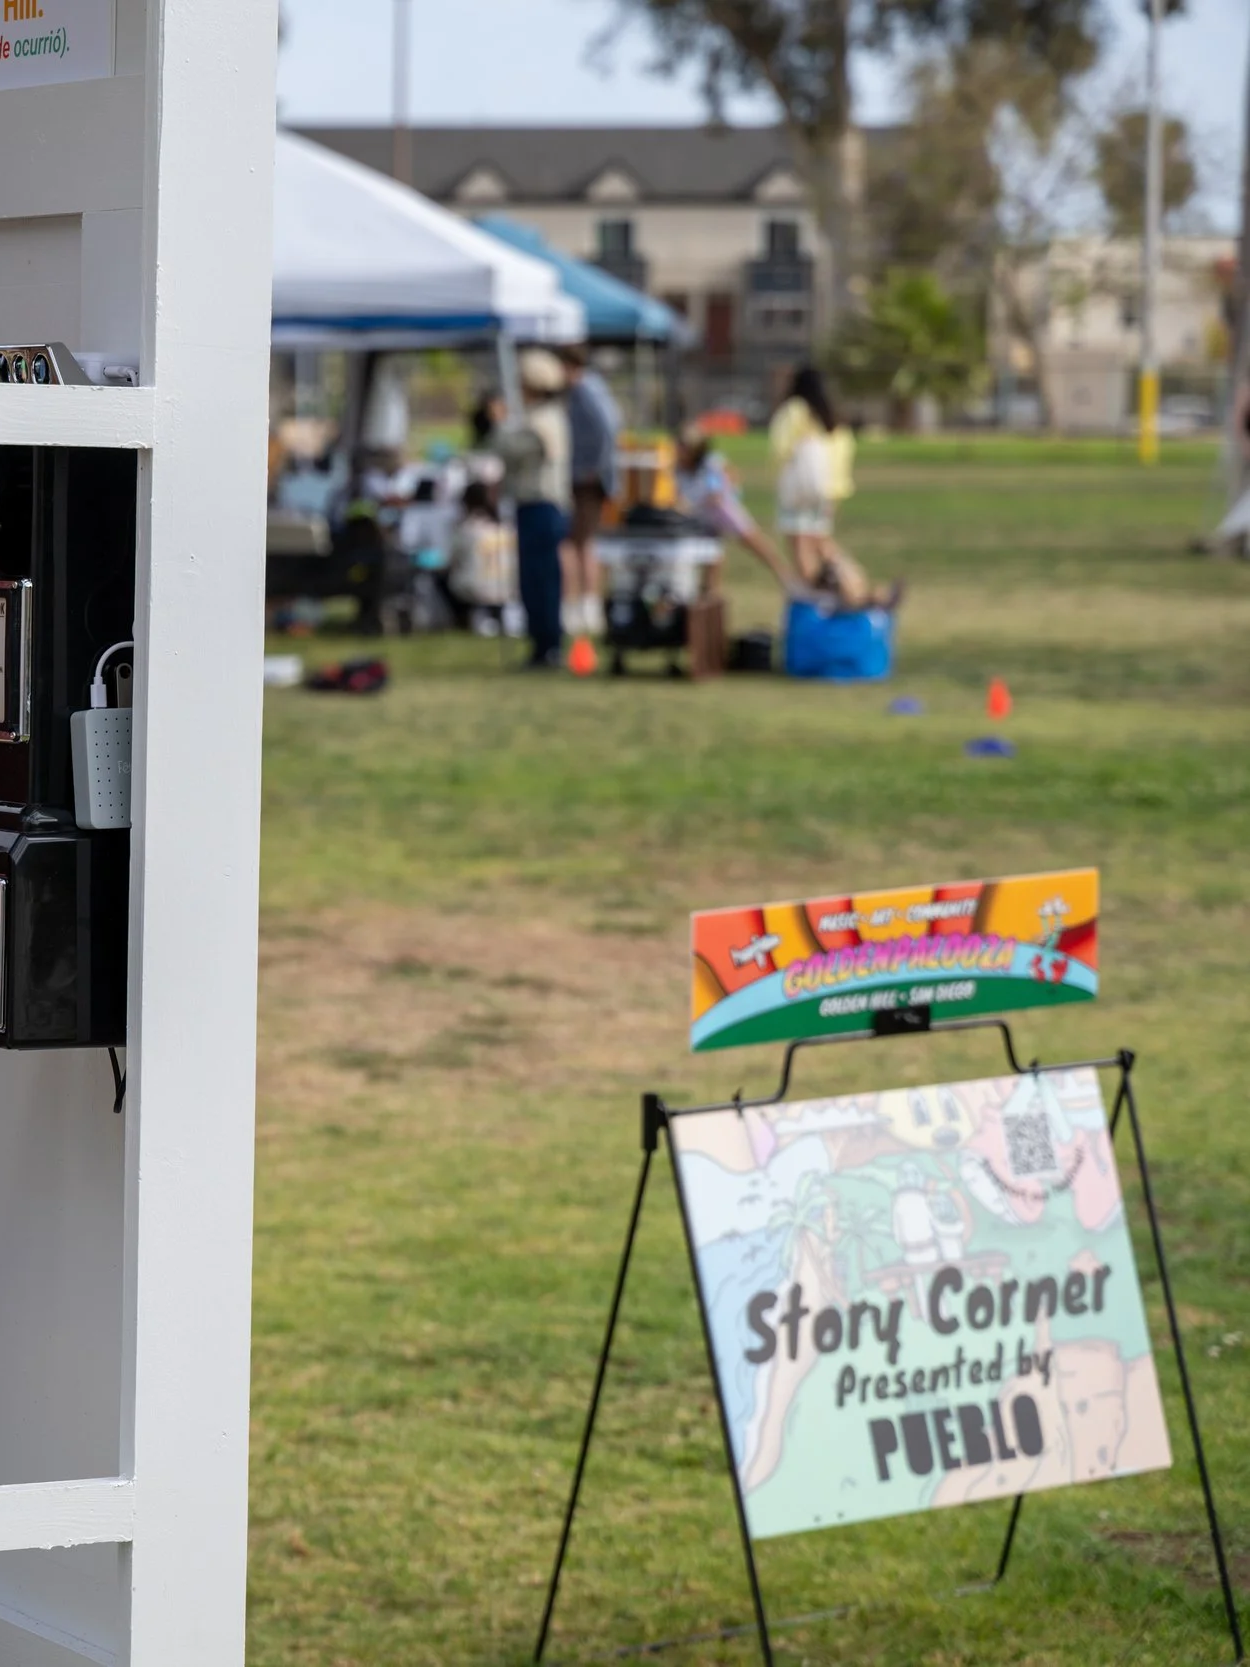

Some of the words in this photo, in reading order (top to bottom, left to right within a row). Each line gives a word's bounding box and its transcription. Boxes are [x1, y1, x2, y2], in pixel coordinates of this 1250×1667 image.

[4, 0, 44, 22] Hill.
[13, 27, 70, 59] ocurrió).
[818, 912, 859, 932] MUSIC
[869, 908, 895, 927] ART
[906, 898, 979, 923] COMMUNITY
[782, 931, 1017, 998] GOLDENPALOOZA
[819, 992, 869, 1017] GOLDEN
[869, 989, 898, 1010] HILL
[907, 985, 934, 1007] SAN
[934, 979, 977, 1003] DIEGO
[744, 1283, 904, 1366] Story
[928, 1264, 1112, 1336] Corner
[835, 1343, 1003, 1408] Presented
[1017, 1339, 1054, 1388] by
[868, 1394, 1046, 1482] PUEBLO
